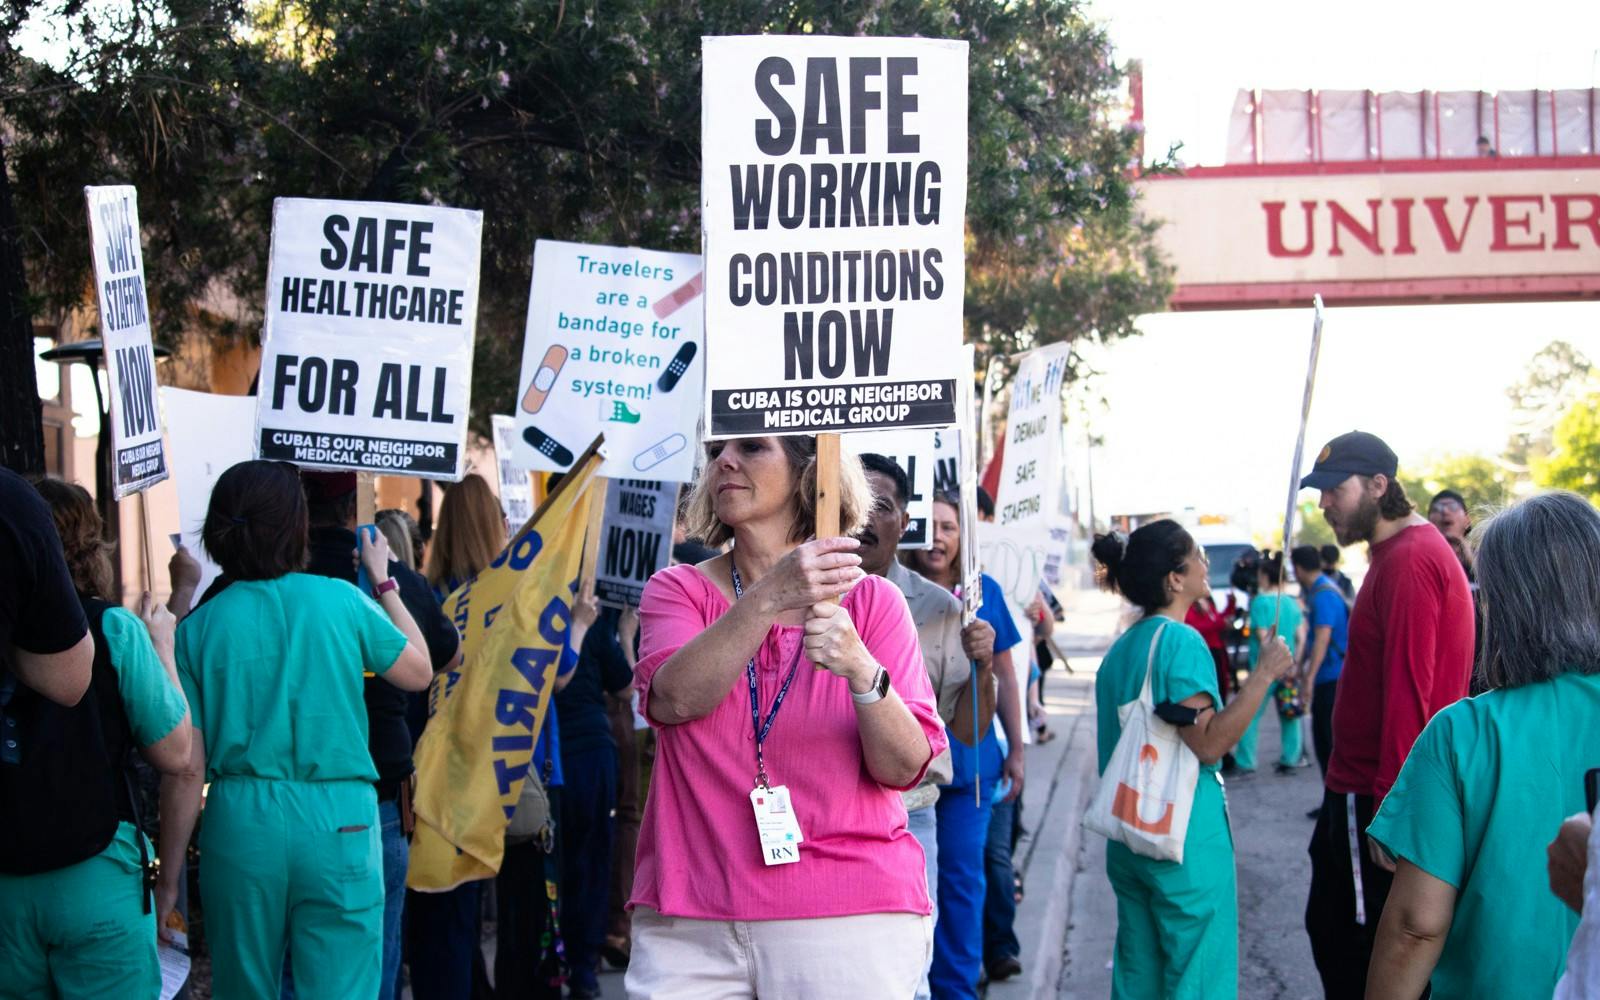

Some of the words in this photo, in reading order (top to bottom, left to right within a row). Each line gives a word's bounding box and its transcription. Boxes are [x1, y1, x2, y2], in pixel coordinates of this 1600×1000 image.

[754, 56, 920, 156] SAFE
[729, 160, 942, 231] WORKING
[100, 196, 137, 275] SAFE
[320, 214, 434, 277] SAFE
[1261, 194, 1600, 259] UNIVER
[577, 255, 674, 281] Travelers
[728, 247, 944, 307] CONDITIONS
[104, 274, 146, 332] STAFFING
[280, 276, 464, 325] HEALTHCARE
[596, 291, 630, 306] are
[636, 295, 648, 309] a
[558, 312, 645, 339] bandage
[651, 321, 681, 340] for
[783, 308, 894, 381] NOW
[570, 347, 581, 361] a
[589, 345, 660, 369] broken
[115, 344, 157, 438] NOW
[272, 354, 359, 416] FOR
[372, 362, 455, 424] ALL
[571, 376, 653, 400] system!
[727, 389, 782, 410] CUBA
[785, 390, 804, 407] IS
[806, 387, 847, 407] OUR
[850, 383, 943, 405] NEIGHBOR
[764, 409, 846, 428] MEDICAL
[848, 404, 910, 423] GROUP
[272, 432, 313, 448] CUBA
[315, 435, 330, 449] IS
[333, 436, 365, 451] OUR
[368, 439, 446, 458] NEIGHBOR
[294, 447, 358, 464] MEDICAL
[360, 451, 413, 469] GROUP
[619, 490, 657, 519] WAGES
[605, 525, 662, 583] NOW
[771, 846, 793, 860] RN
